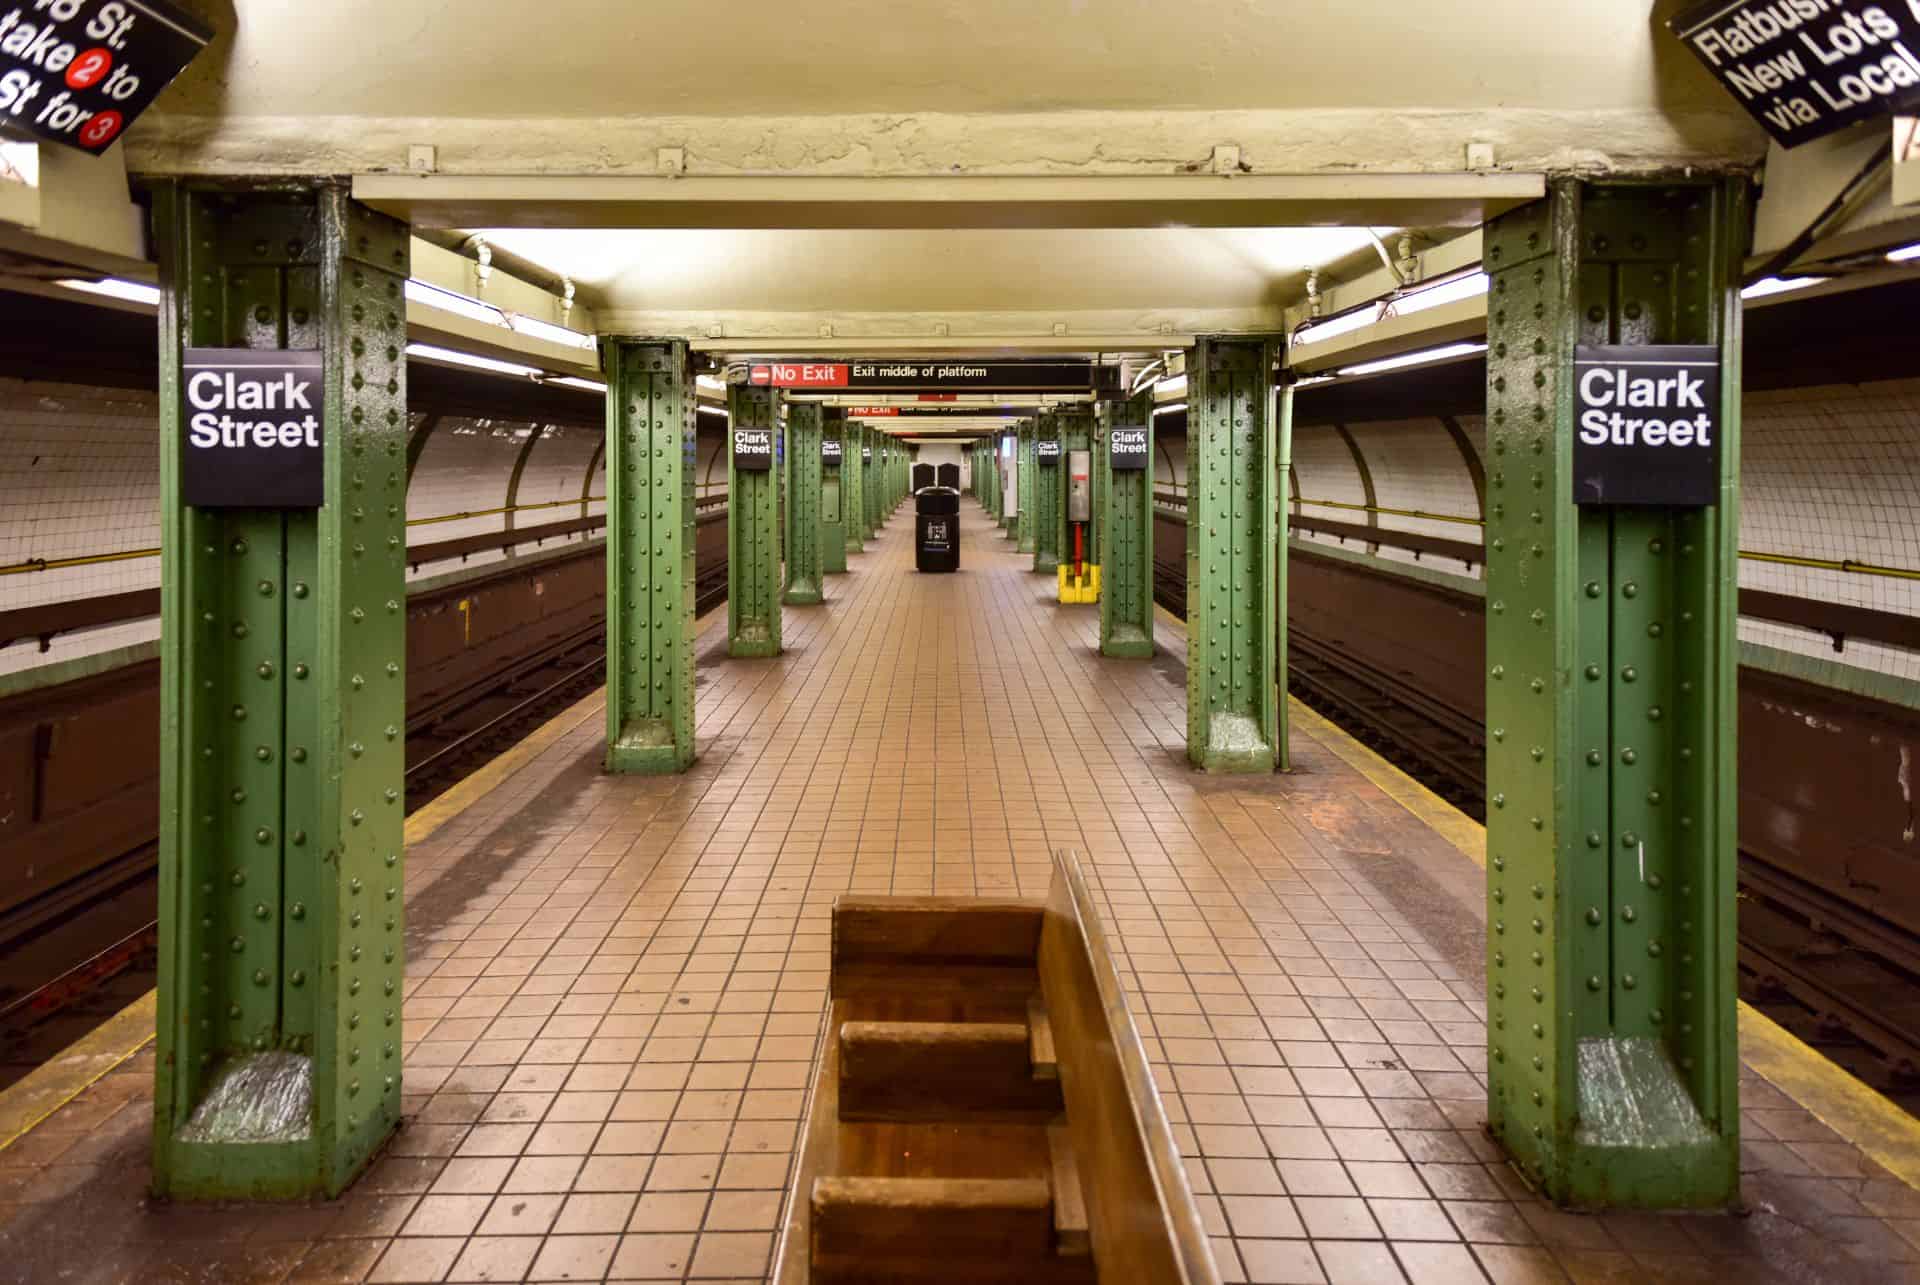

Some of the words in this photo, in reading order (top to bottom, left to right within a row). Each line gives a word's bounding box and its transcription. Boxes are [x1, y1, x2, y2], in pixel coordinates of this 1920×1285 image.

[86, 2, 136, 50] St.
[1693, 0, 1841, 66] Flatbus
[0, 8, 77, 73] take
[70, 53, 106, 85] 2
[101, 63, 140, 100] to
[1724, 49, 1806, 99] New
[1798, 5, 1899, 65] Lots
[1764, 96, 1821, 131] via
[1809, 39, 1920, 111] Local
[35, 91, 94, 133] for
[85, 114, 117, 142] 3
[188, 371, 312, 410] Clark
[771, 365, 796, 381] No
[802, 365, 835, 381] Exit
[852, 366, 876, 377] Exit
[879, 366, 918, 377] middle
[921, 366, 934, 377] of
[938, 366, 987, 379] platform
[1579, 367, 1705, 408] Clark
[190, 412, 319, 448] Street
[735, 431, 769, 443] Clark
[1111, 431, 1145, 443] Clark
[1579, 409, 1712, 447] Street
[735, 444, 771, 454] Street
[1111, 443, 1147, 453] Street
